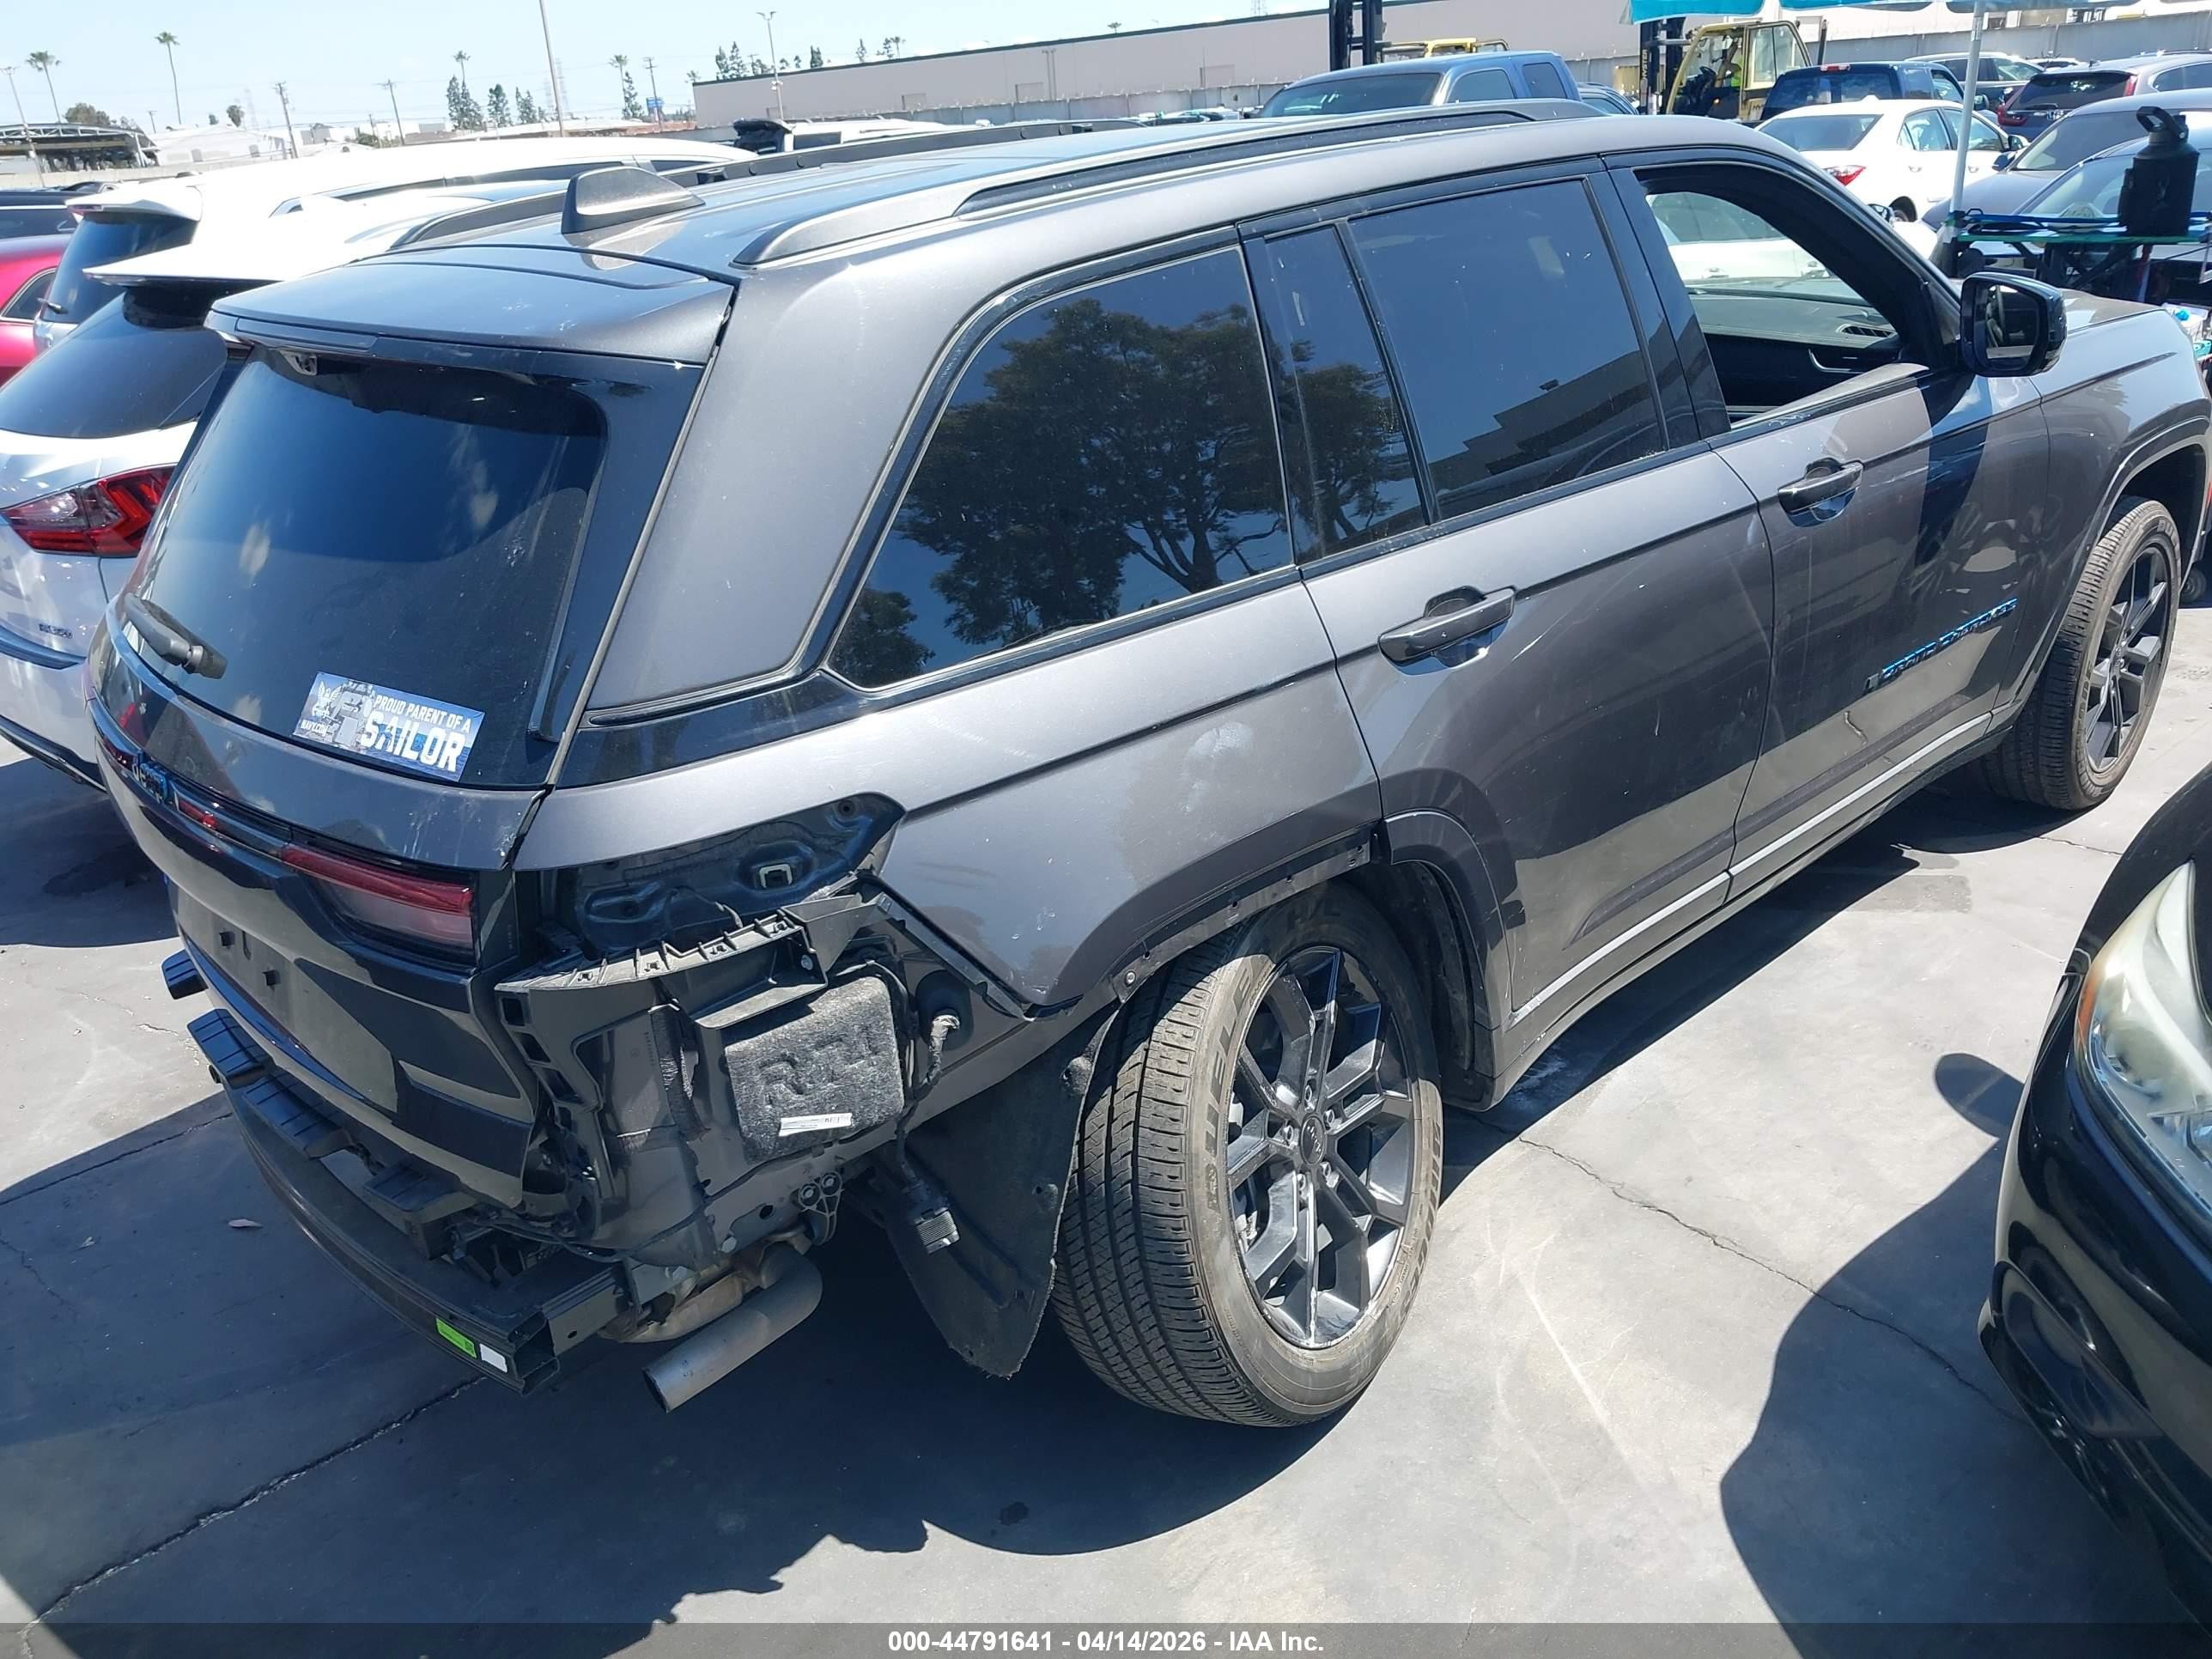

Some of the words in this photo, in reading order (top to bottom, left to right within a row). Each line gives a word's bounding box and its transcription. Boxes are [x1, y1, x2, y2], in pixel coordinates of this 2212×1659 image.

[374, 694, 407, 715] PROUD
[405, 702, 447, 724] PARENT
[446, 712, 465, 730] OF
[460, 717, 471, 733] A
[360, 710, 466, 773] SAILOR
